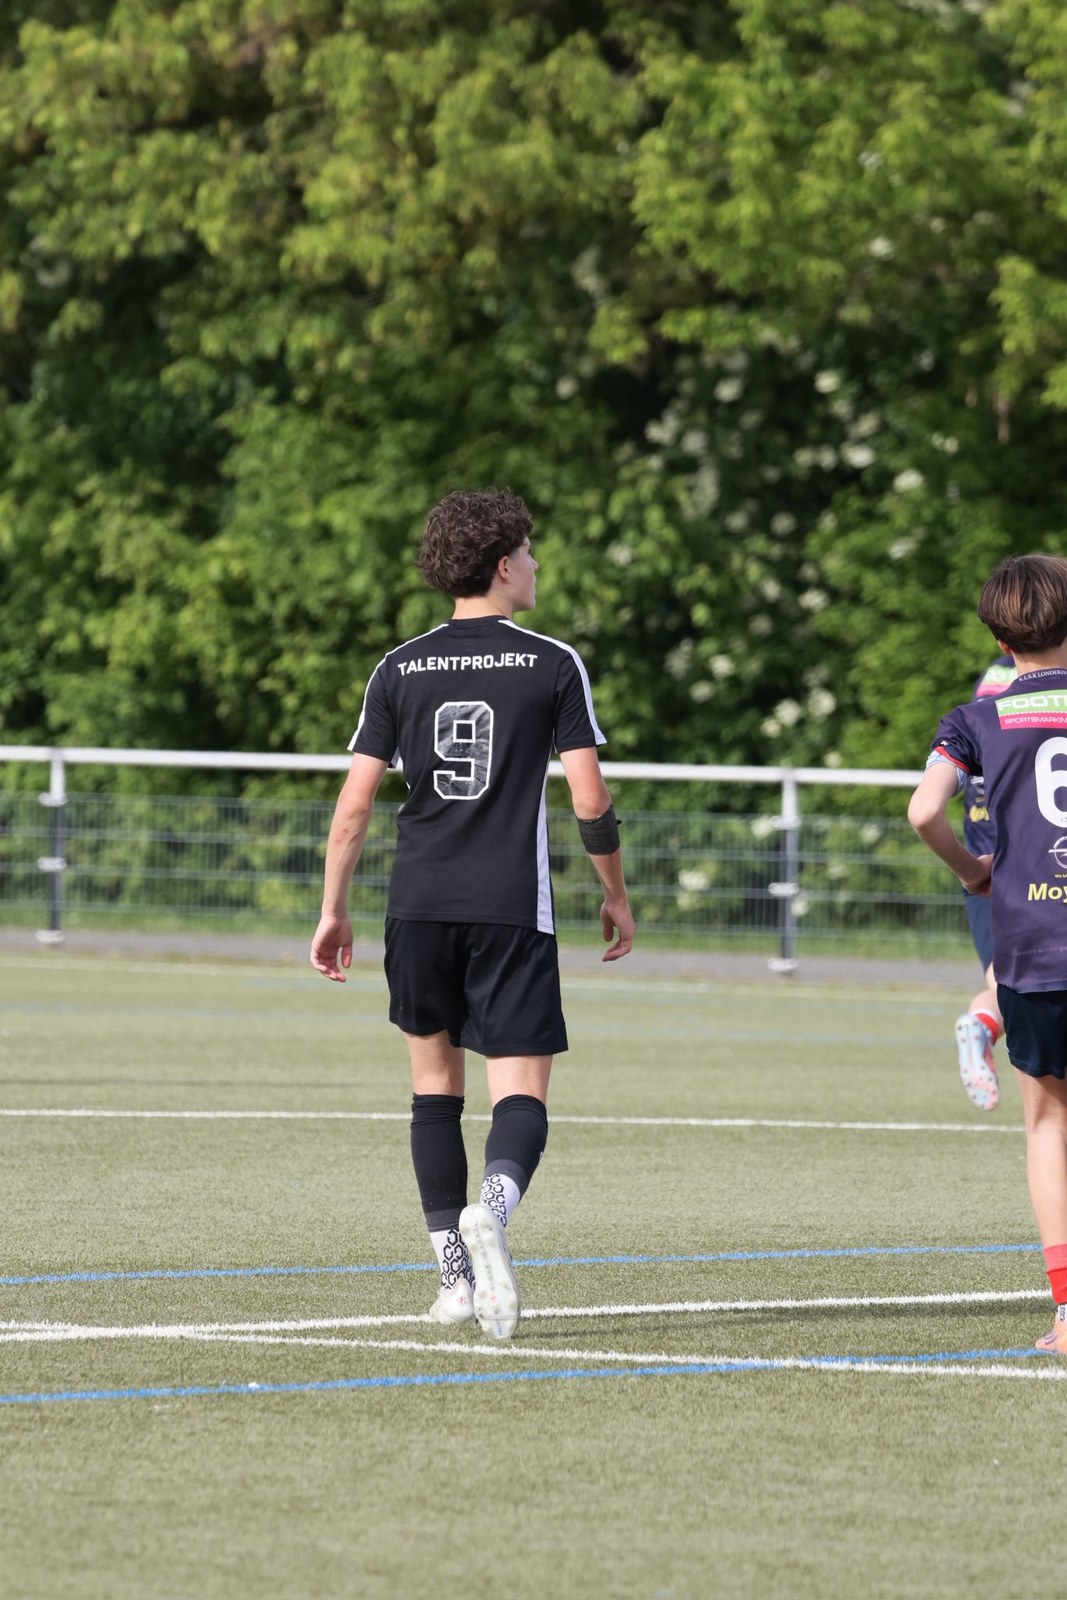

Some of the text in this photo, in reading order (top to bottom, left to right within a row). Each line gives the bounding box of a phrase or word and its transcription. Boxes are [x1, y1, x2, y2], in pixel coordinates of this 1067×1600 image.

[398, 653, 537, 676] TALENTPROJEKT
[433, 701, 494, 800] 9
[1034, 736, 1067, 829] 6
